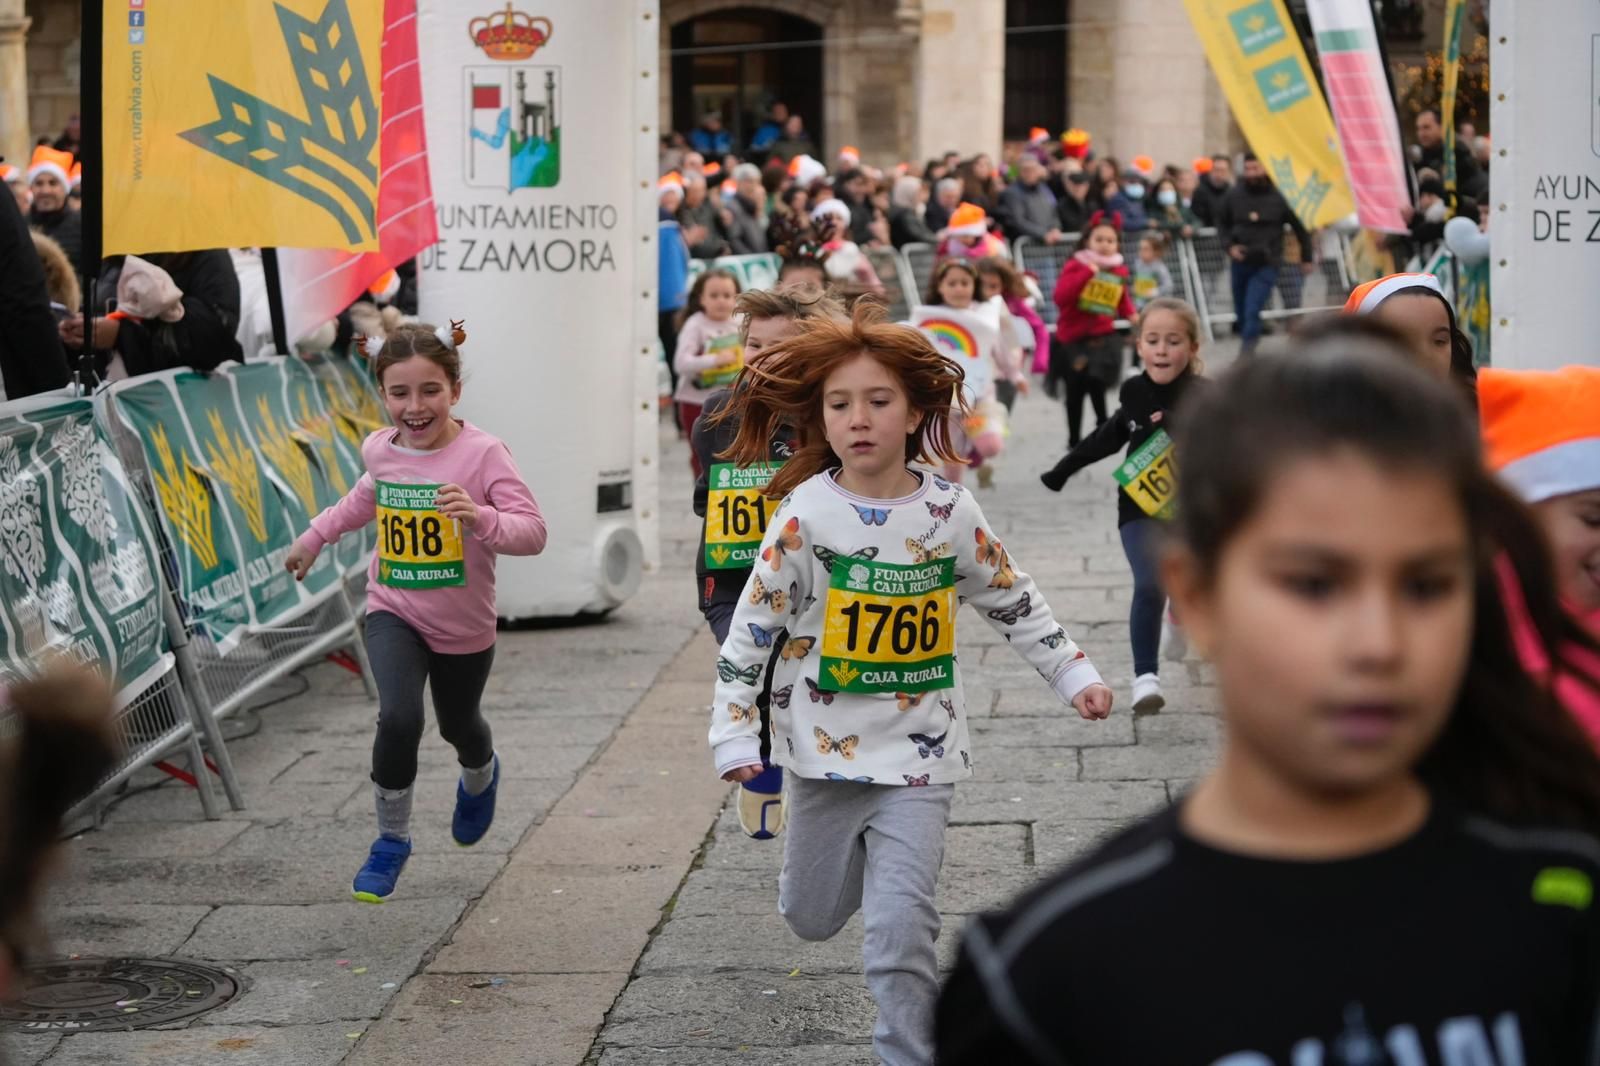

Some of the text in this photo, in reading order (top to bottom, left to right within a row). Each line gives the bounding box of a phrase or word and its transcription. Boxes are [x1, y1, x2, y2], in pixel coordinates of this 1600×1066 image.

[128, 50, 143, 181] www.ruralvia.com
[435, 204, 617, 229] UNTAMIENTO
[1533, 209, 1571, 242] DE
[458, 238, 616, 272] ZAMORA
[389, 497, 408, 508] CAJA
[718, 495, 775, 536] 161
[382, 513, 443, 557] 1618
[392, 568, 459, 581] CAJA RURAL
[873, 576, 942, 594] CAJA RURAL
[841, 600, 940, 655] 1766
[861, 665, 946, 684] CAJA RURAL
